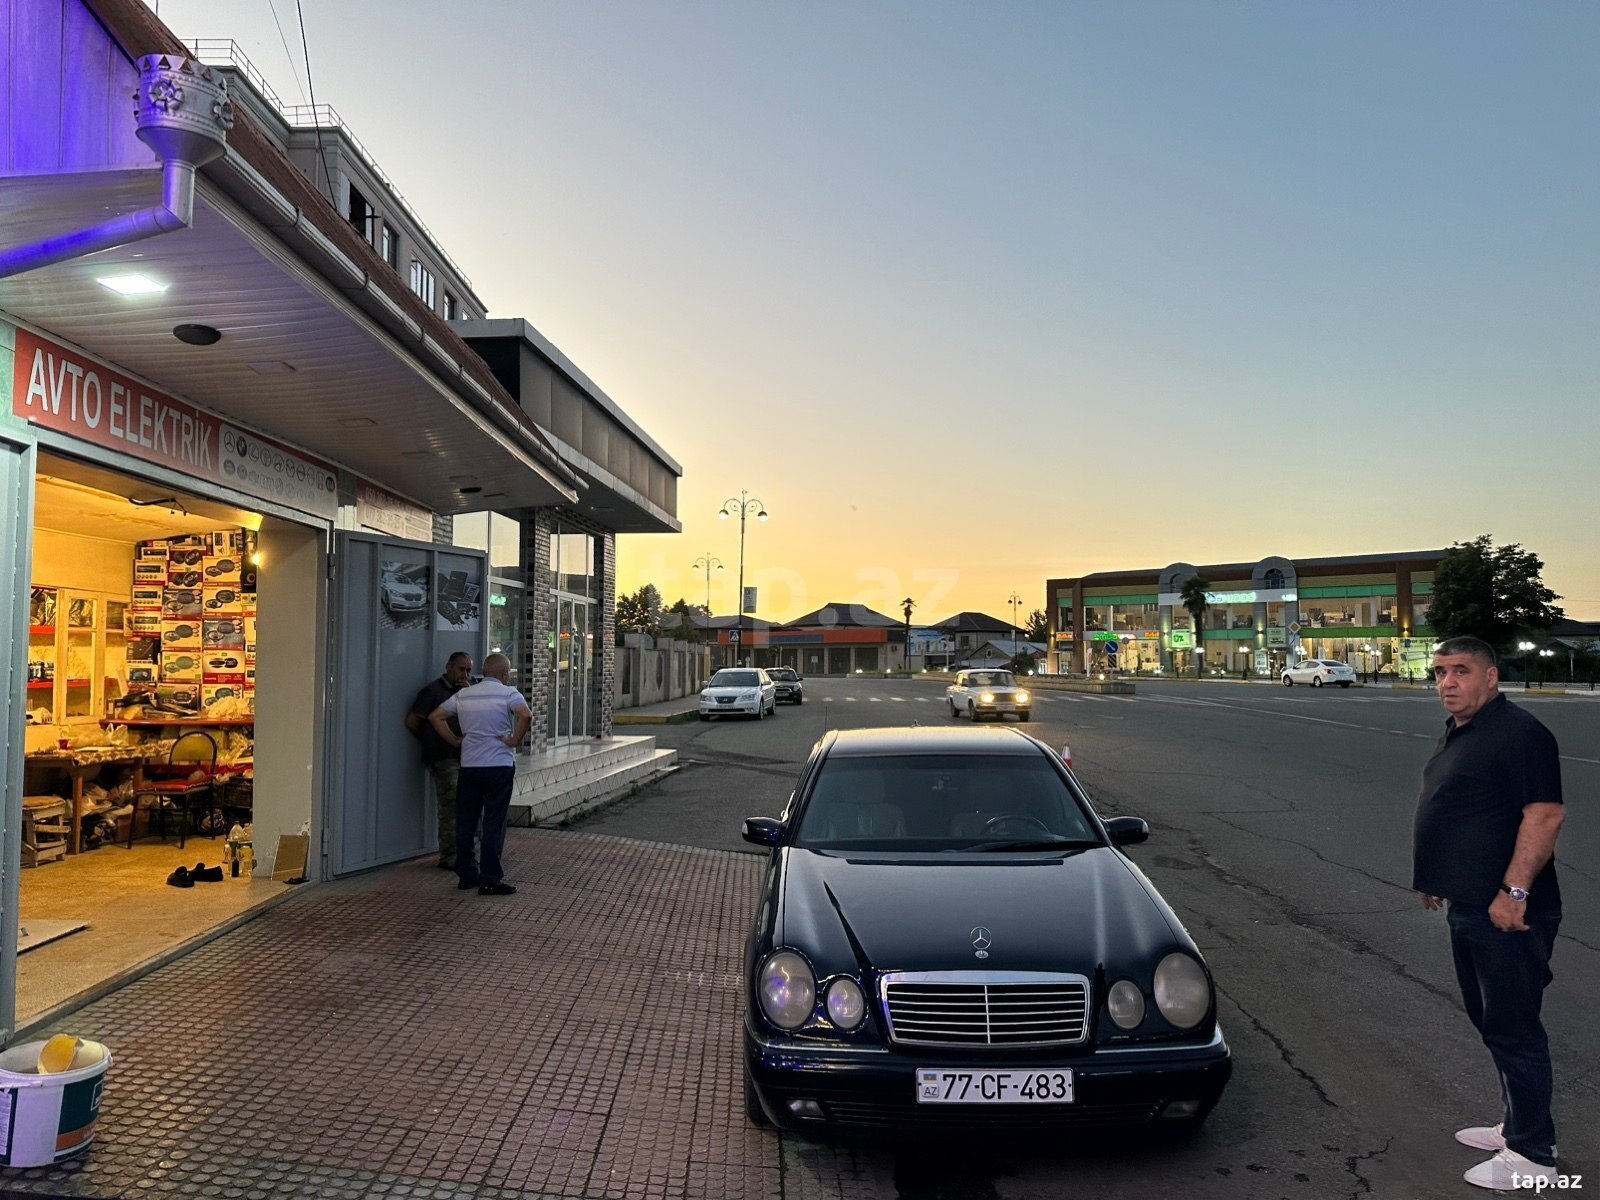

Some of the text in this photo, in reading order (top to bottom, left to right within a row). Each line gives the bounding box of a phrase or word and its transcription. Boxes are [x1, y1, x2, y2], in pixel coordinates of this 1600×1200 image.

[25, 347, 213, 472] AVTO ELEKTRİK
[924, 1073, 1067, 1100] AZ 77-CF-483
